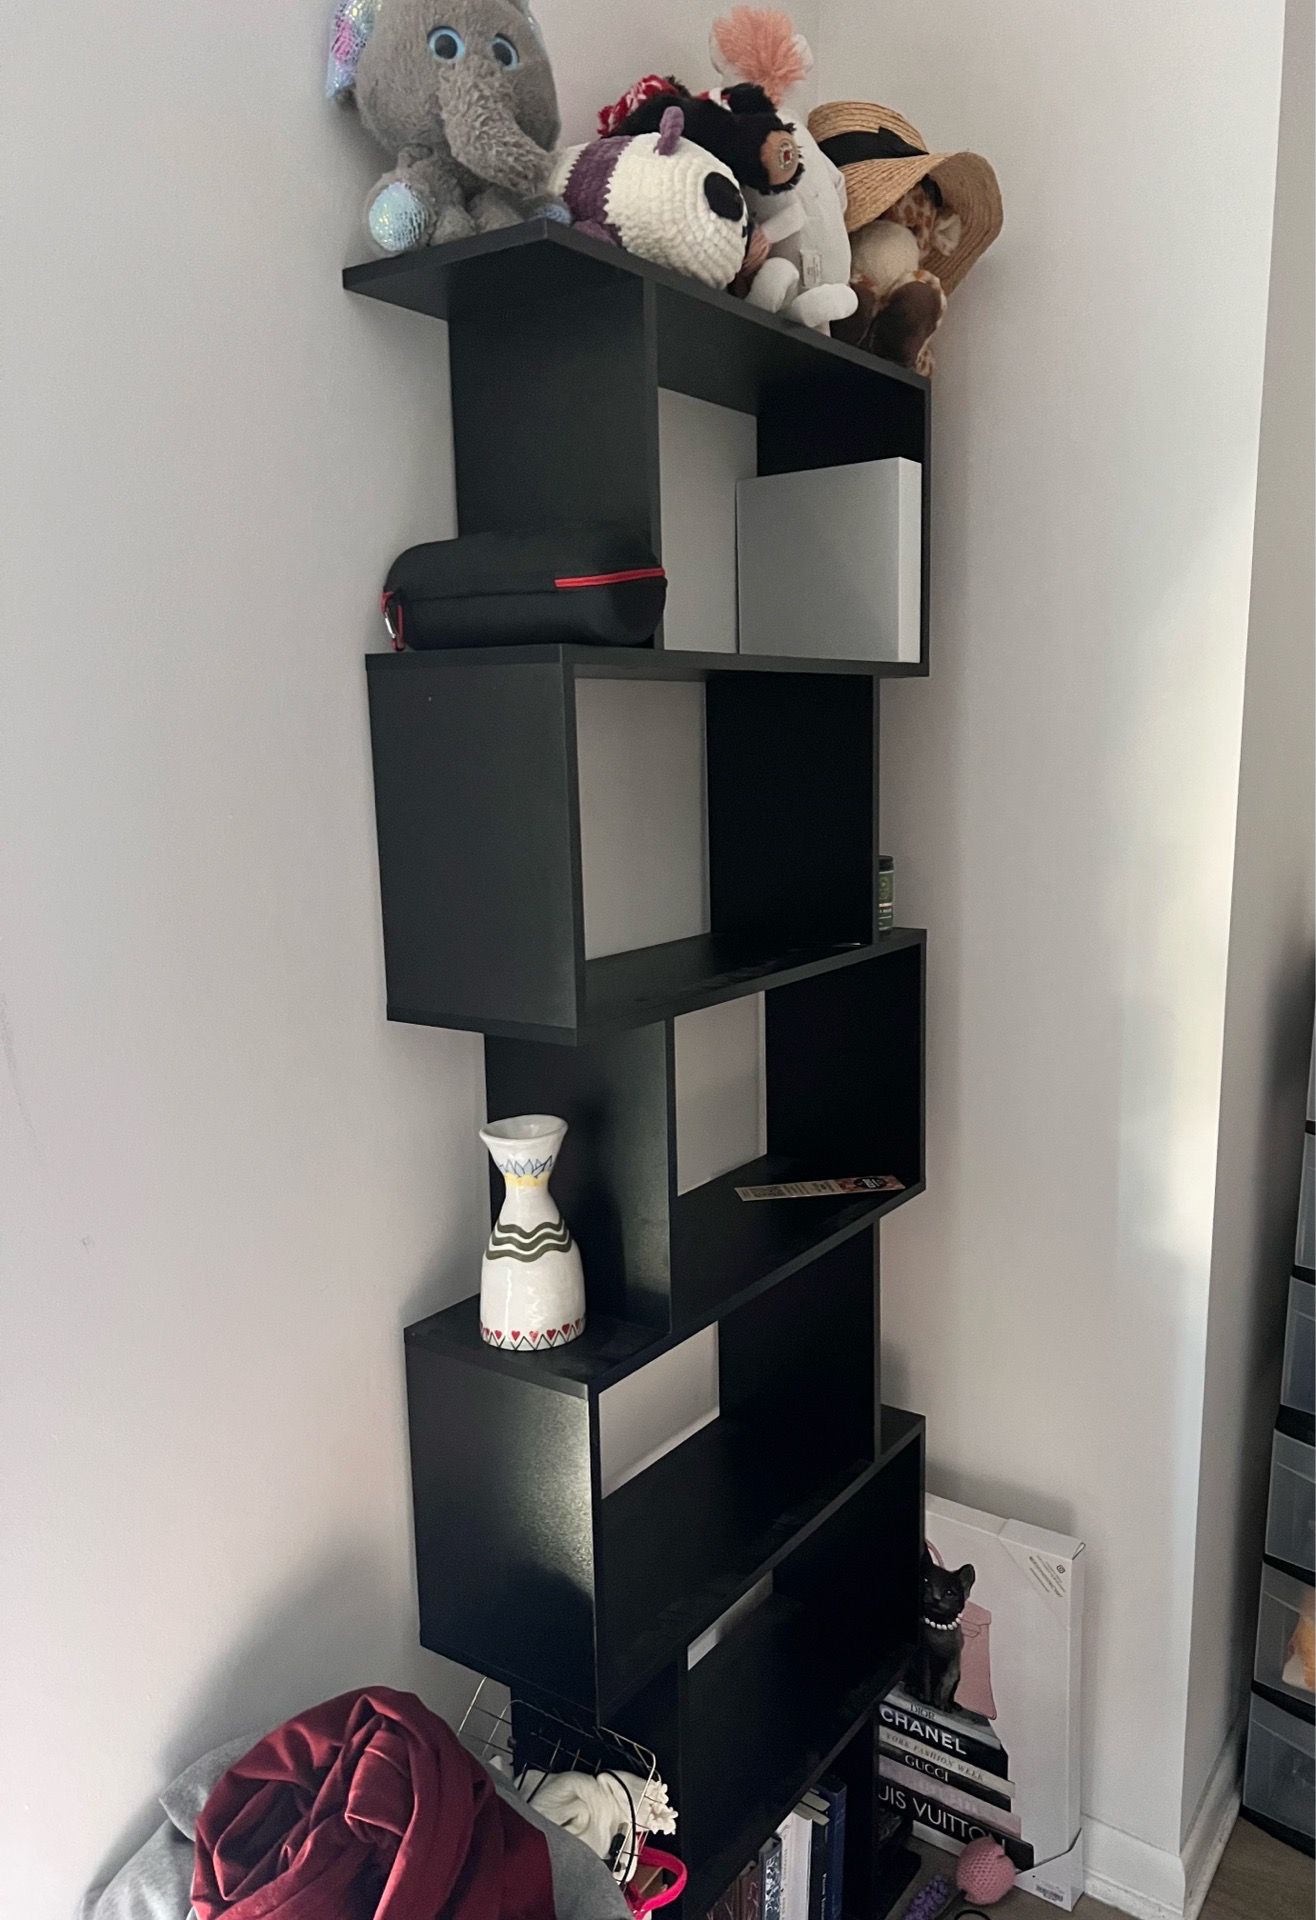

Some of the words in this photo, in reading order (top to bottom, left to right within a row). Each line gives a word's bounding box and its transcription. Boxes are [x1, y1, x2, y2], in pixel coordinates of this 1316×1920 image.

[910, 1704, 936, 1721] DIOR
[880, 1706, 967, 1755] CHANEL
[905, 1755, 949, 1783] GUCCI
[914, 1744, 954, 1768] FASHION
[958, 1765, 984, 1782] WEEK
